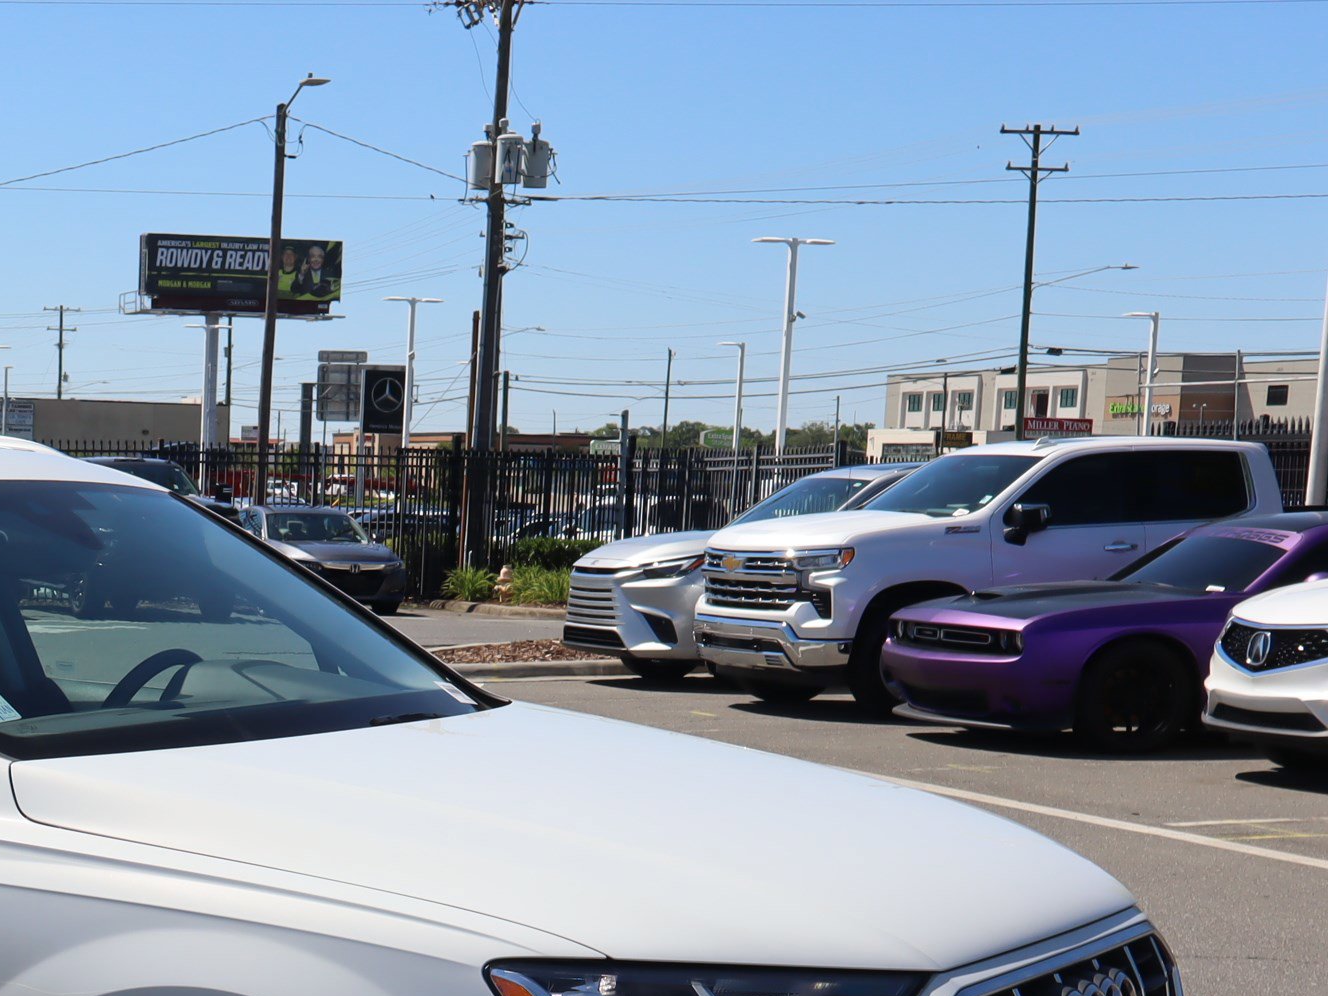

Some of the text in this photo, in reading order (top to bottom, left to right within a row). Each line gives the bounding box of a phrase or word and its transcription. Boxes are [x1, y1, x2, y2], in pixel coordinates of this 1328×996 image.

[156, 247, 211, 268] ROWDY
[212, 250, 223, 269] &
[1027, 420, 1090, 431] MILLER PIANO
